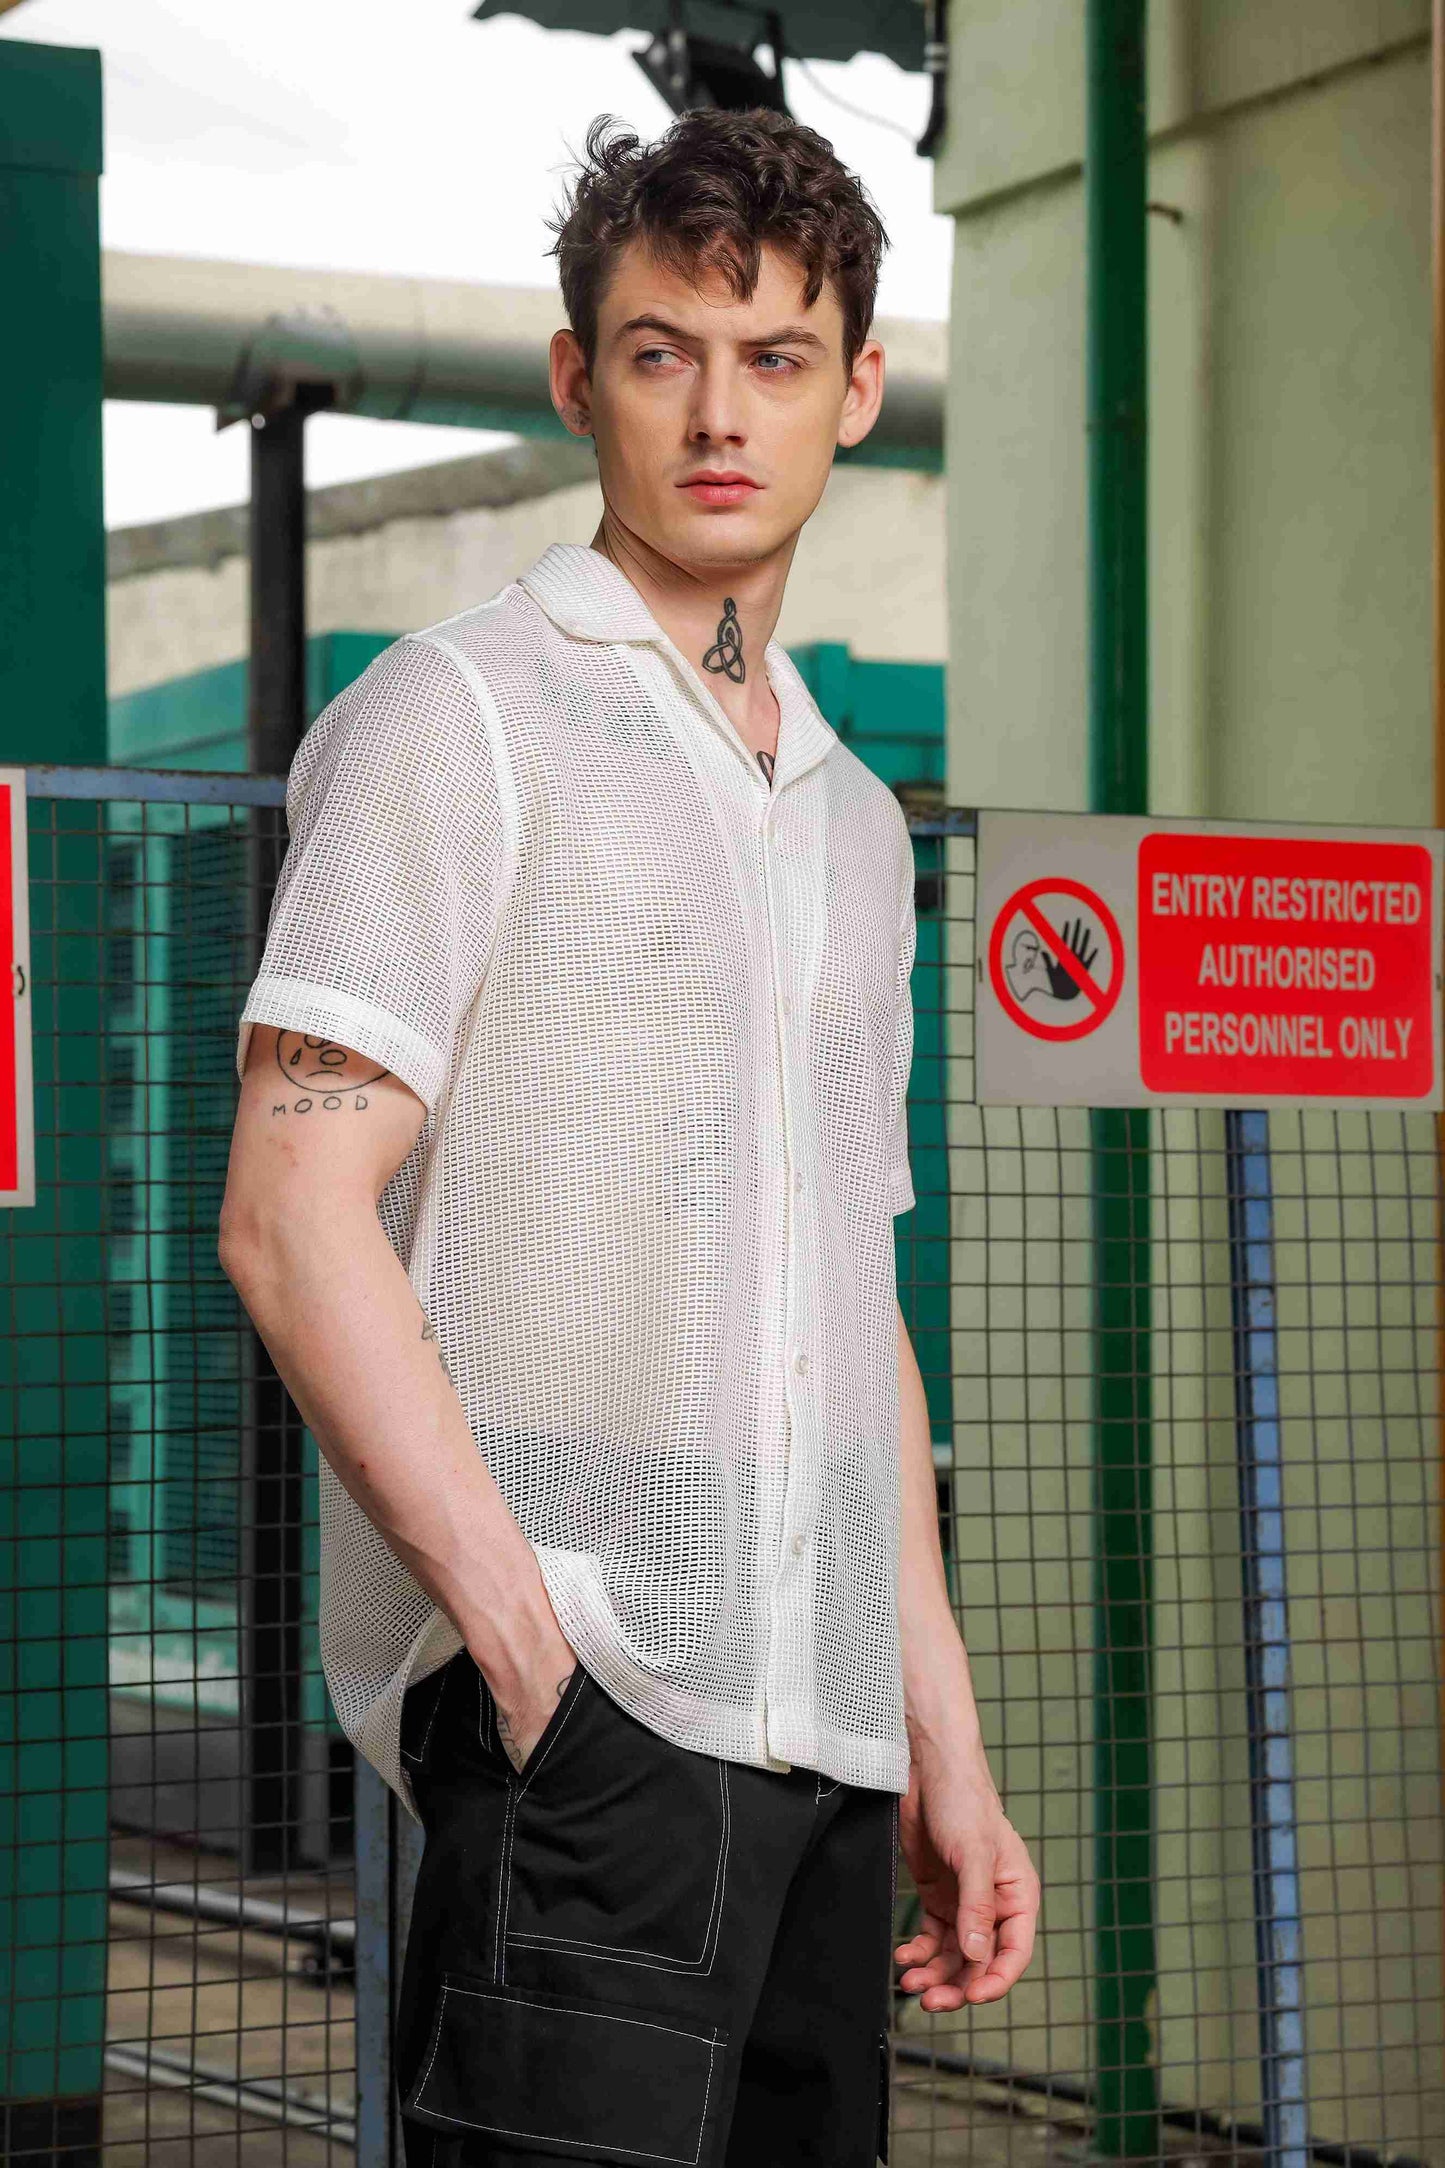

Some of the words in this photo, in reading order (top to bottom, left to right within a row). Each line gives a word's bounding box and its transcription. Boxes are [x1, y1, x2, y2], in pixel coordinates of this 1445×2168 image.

[1152, 873, 1246, 918] ENTRY
[1252, 877, 1421, 924] RESTRICTED
[1198, 944, 1376, 990] AUTHORISED
[1165, 1012, 1333, 1058] PERSONNEL
[1339, 1018, 1413, 1059] ONLY
[272, 1095, 369, 1117] MOOD
